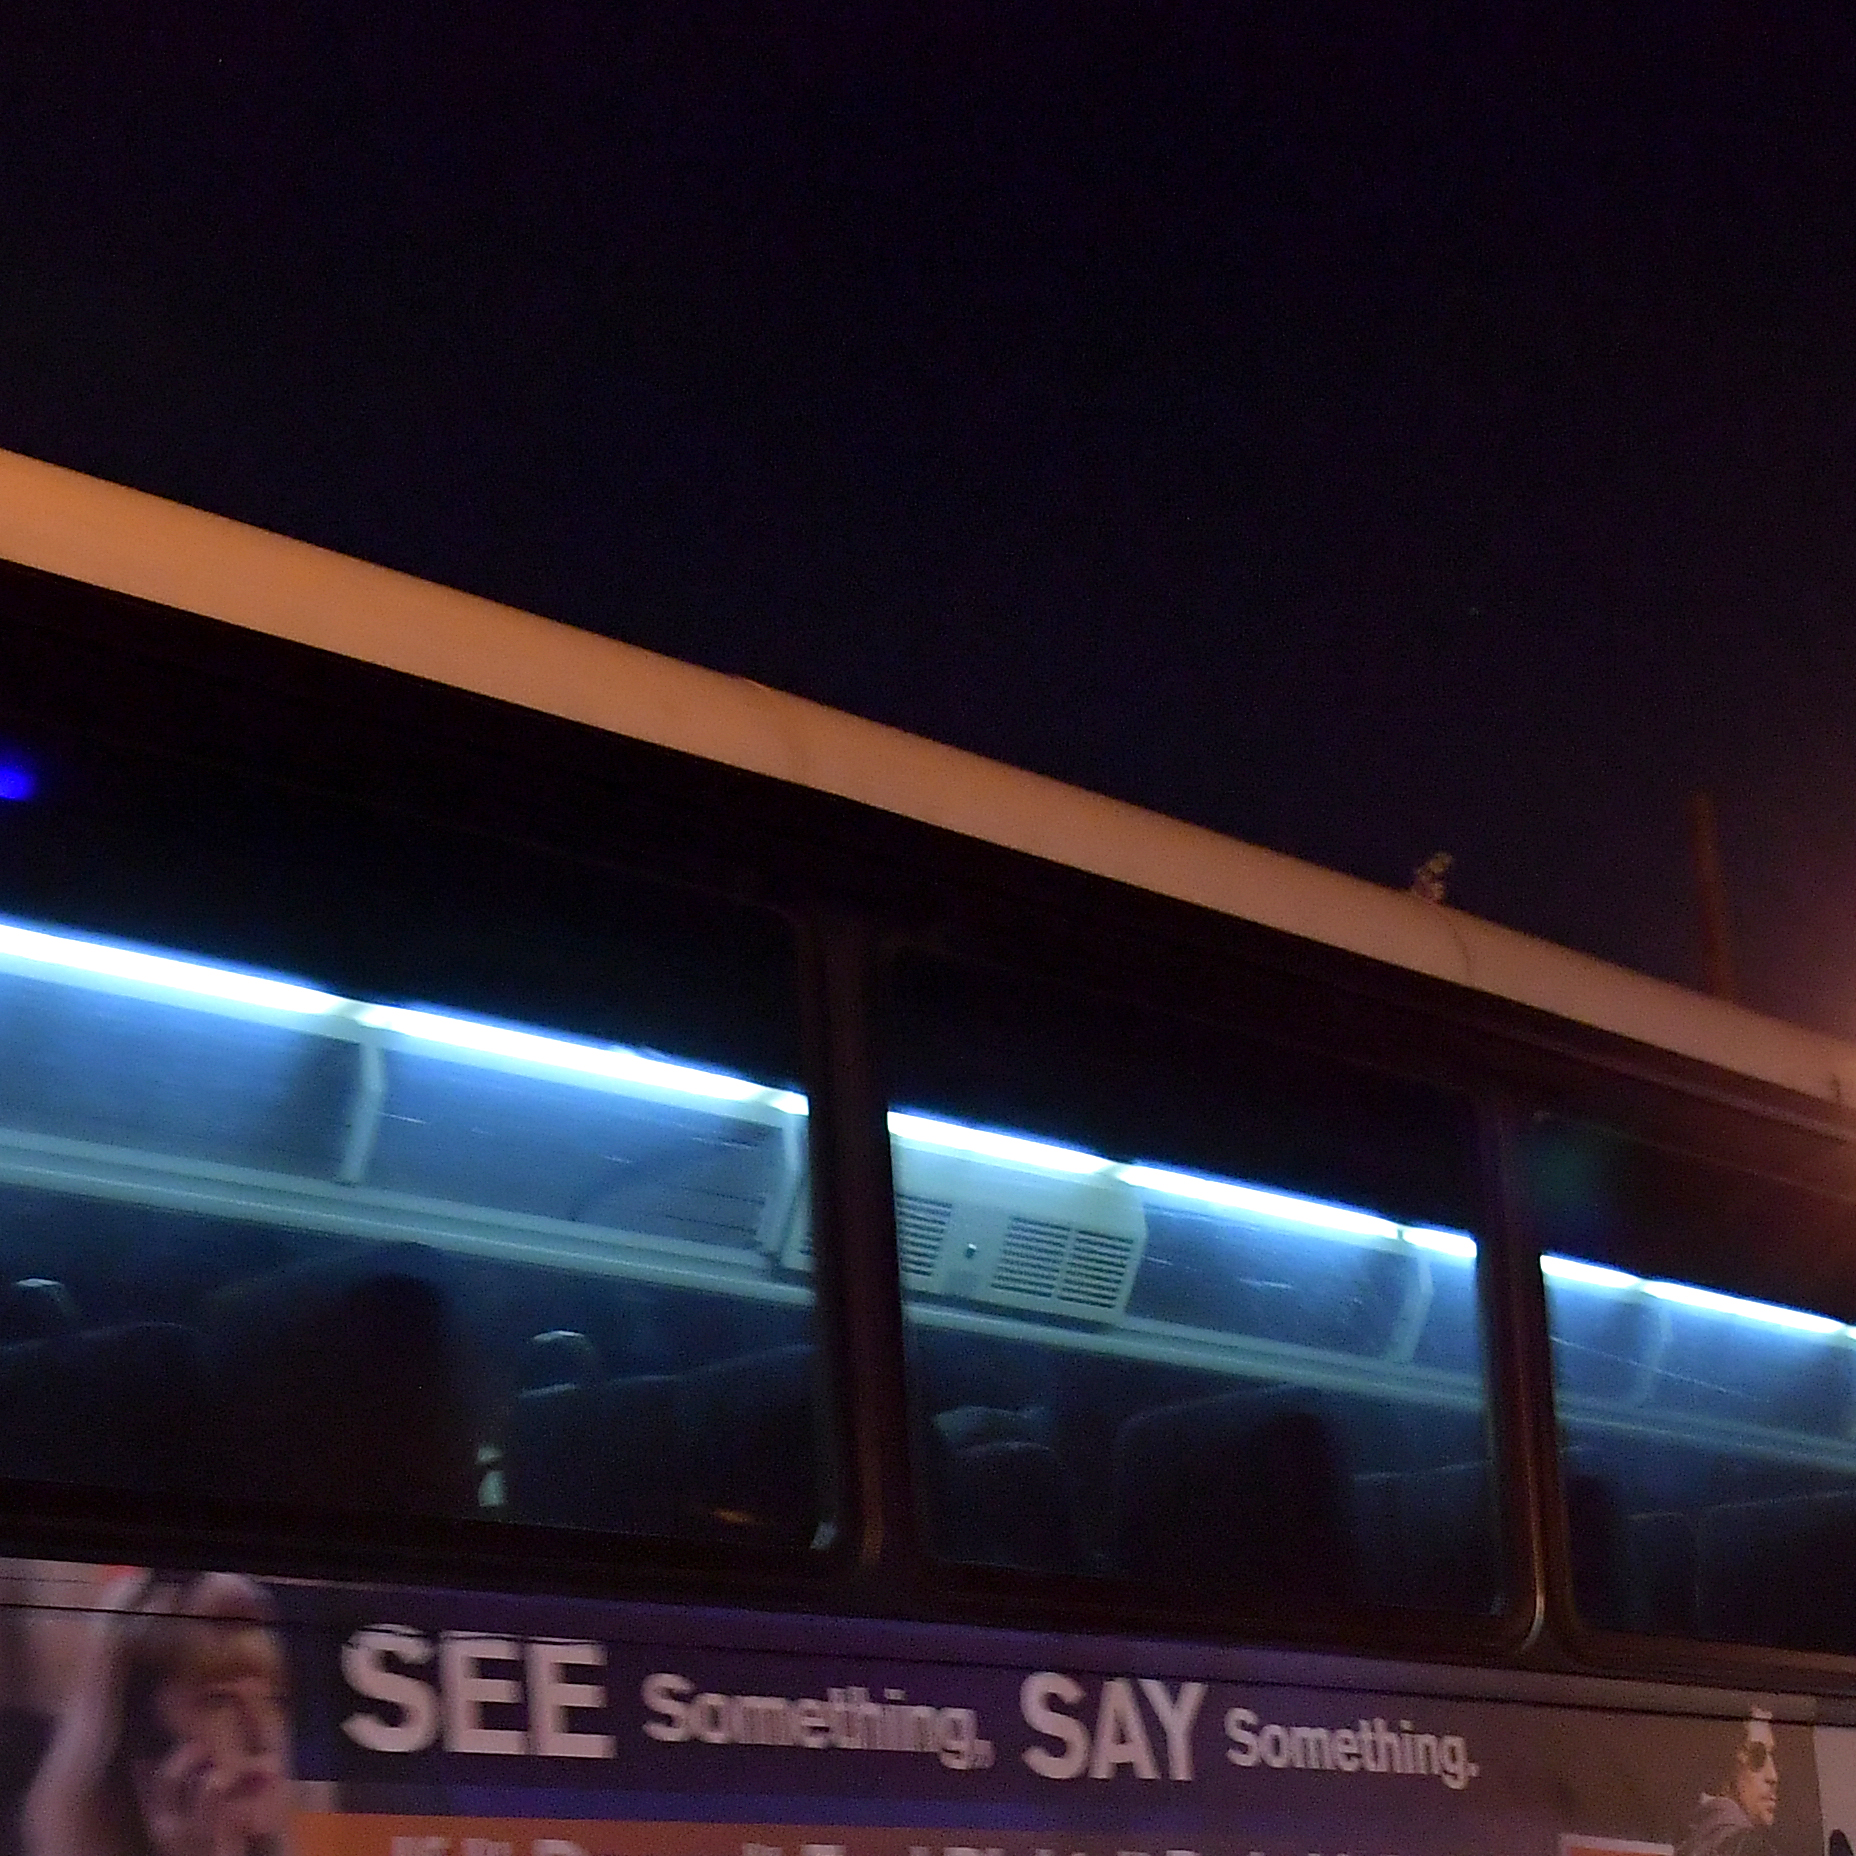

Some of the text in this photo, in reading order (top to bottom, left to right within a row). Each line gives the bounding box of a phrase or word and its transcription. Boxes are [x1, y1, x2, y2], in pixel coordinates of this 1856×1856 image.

[342, 1623, 1480, 1791] SEE Something, SAY Something.
